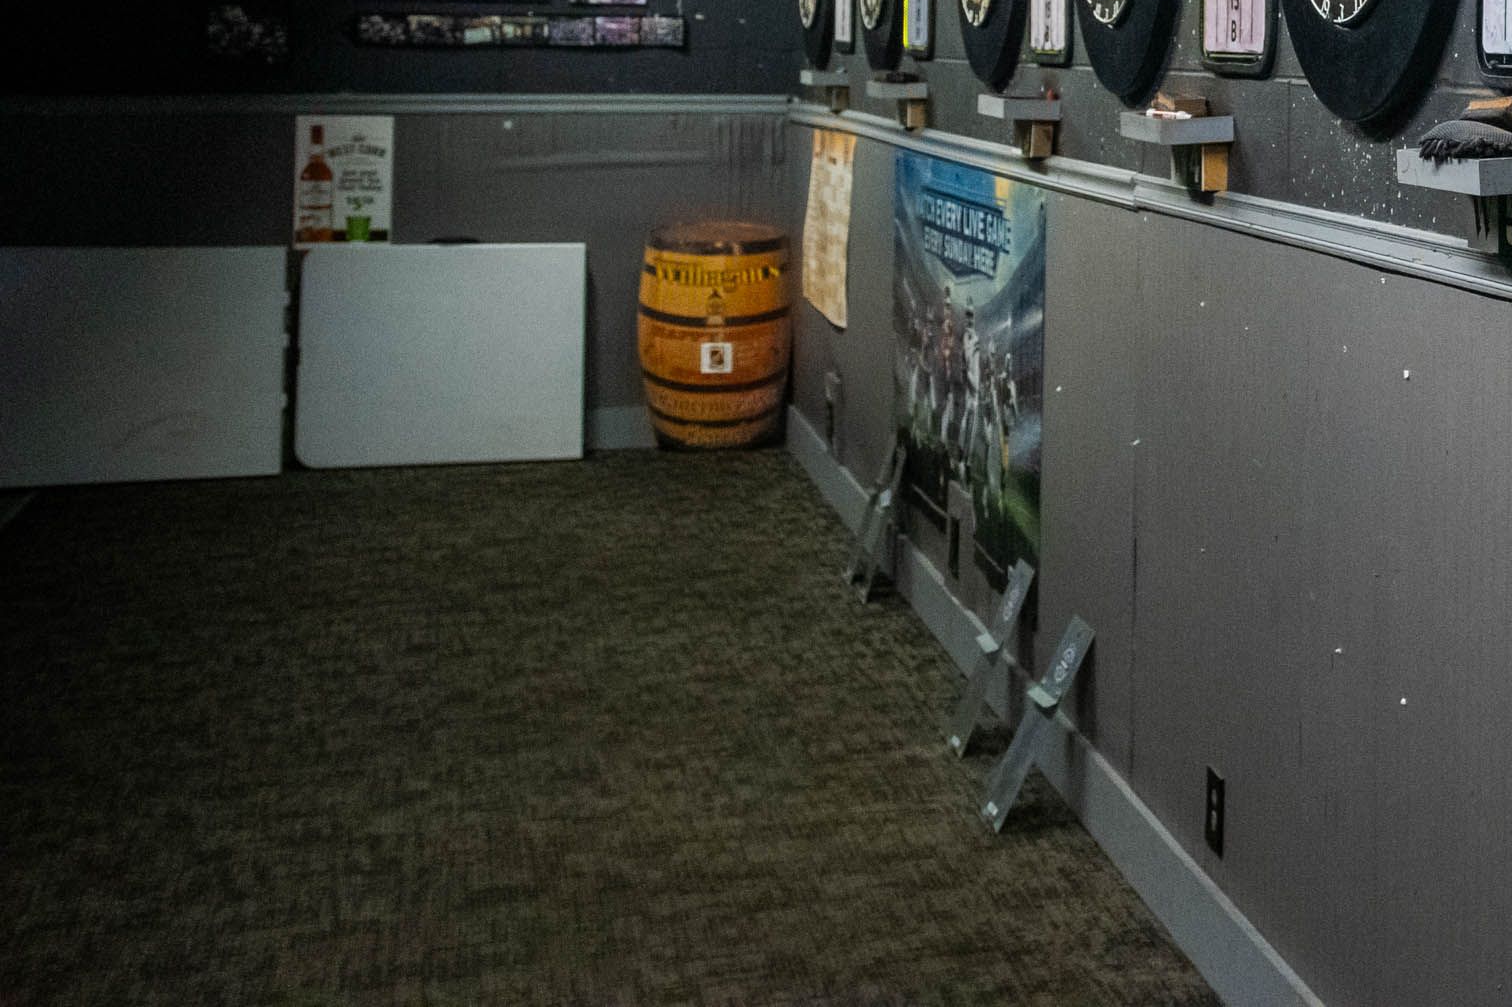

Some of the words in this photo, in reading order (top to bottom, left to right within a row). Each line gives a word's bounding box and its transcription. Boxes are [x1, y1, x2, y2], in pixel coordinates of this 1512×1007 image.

[1230, 19, 1237, 42] B
[936, 198, 962, 232] EVERY
[963, 206, 986, 241] LIVE
[986, 210, 1011, 254] GAME
